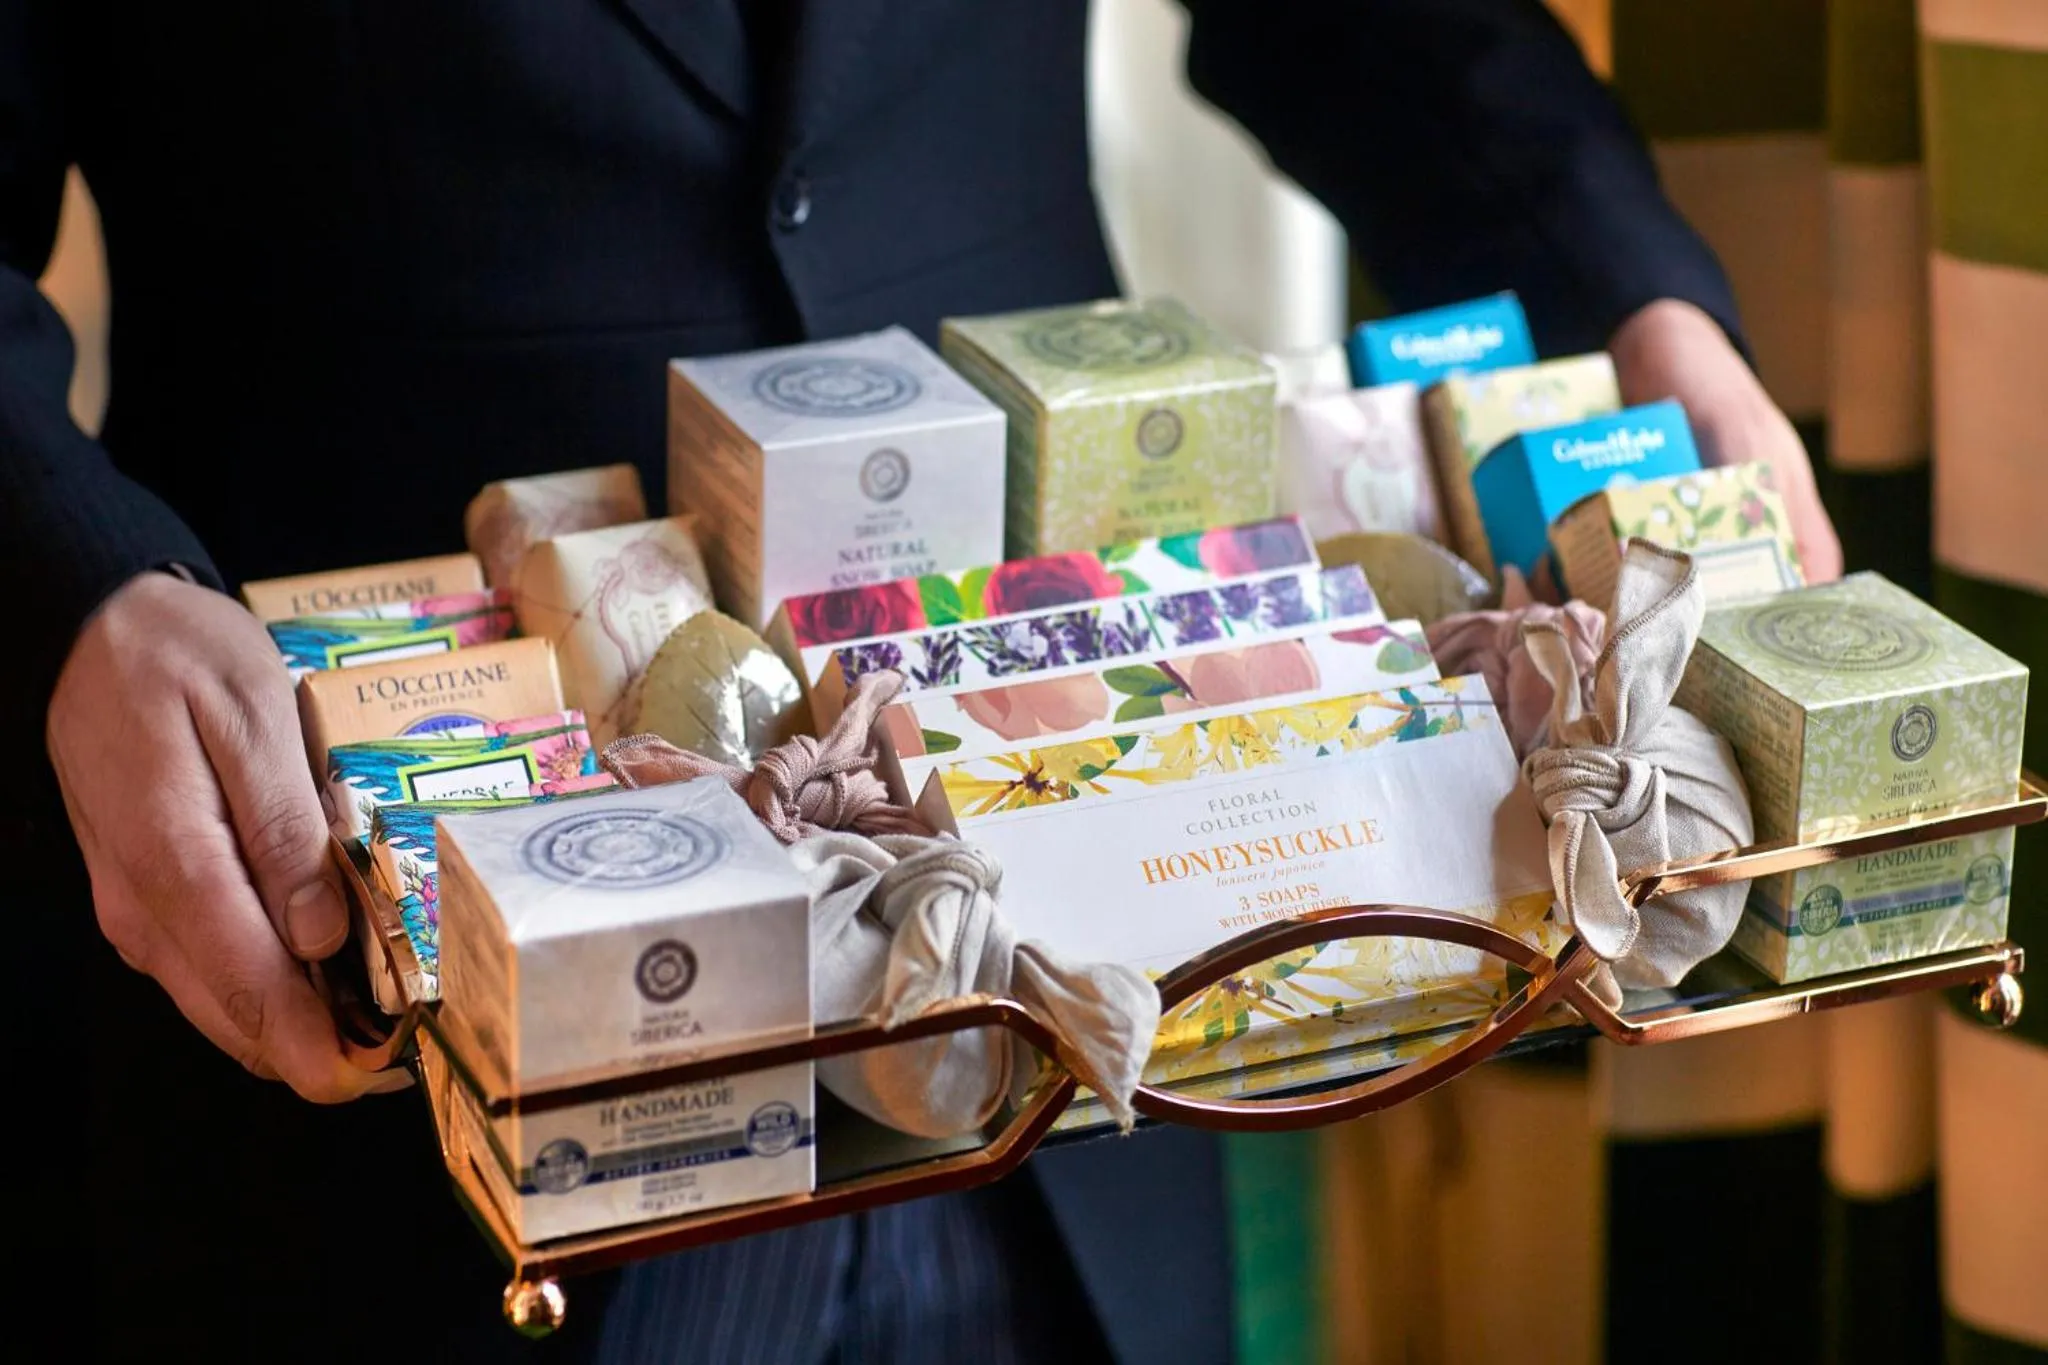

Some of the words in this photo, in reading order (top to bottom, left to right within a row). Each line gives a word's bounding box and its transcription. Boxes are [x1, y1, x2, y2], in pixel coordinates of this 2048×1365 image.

[355, 661, 511, 704] L'OCCITANE
[414, 689, 486, 709] PROVENCE
[1208, 788, 1284, 813] FLORAL
[1186, 801, 1318, 836] COLLECTION
[1140, 818, 1385, 885] HONEYSUCKLE
[1856, 839, 1959, 874] HANDMADE
[1271, 860, 1326, 881] japonica
[1239, 896, 1250, 911] 3
[1257, 883, 1321, 907] SOAPS
[1218, 912, 1258, 929] WITH
[599, 1087, 735, 1129] HANDMADE
